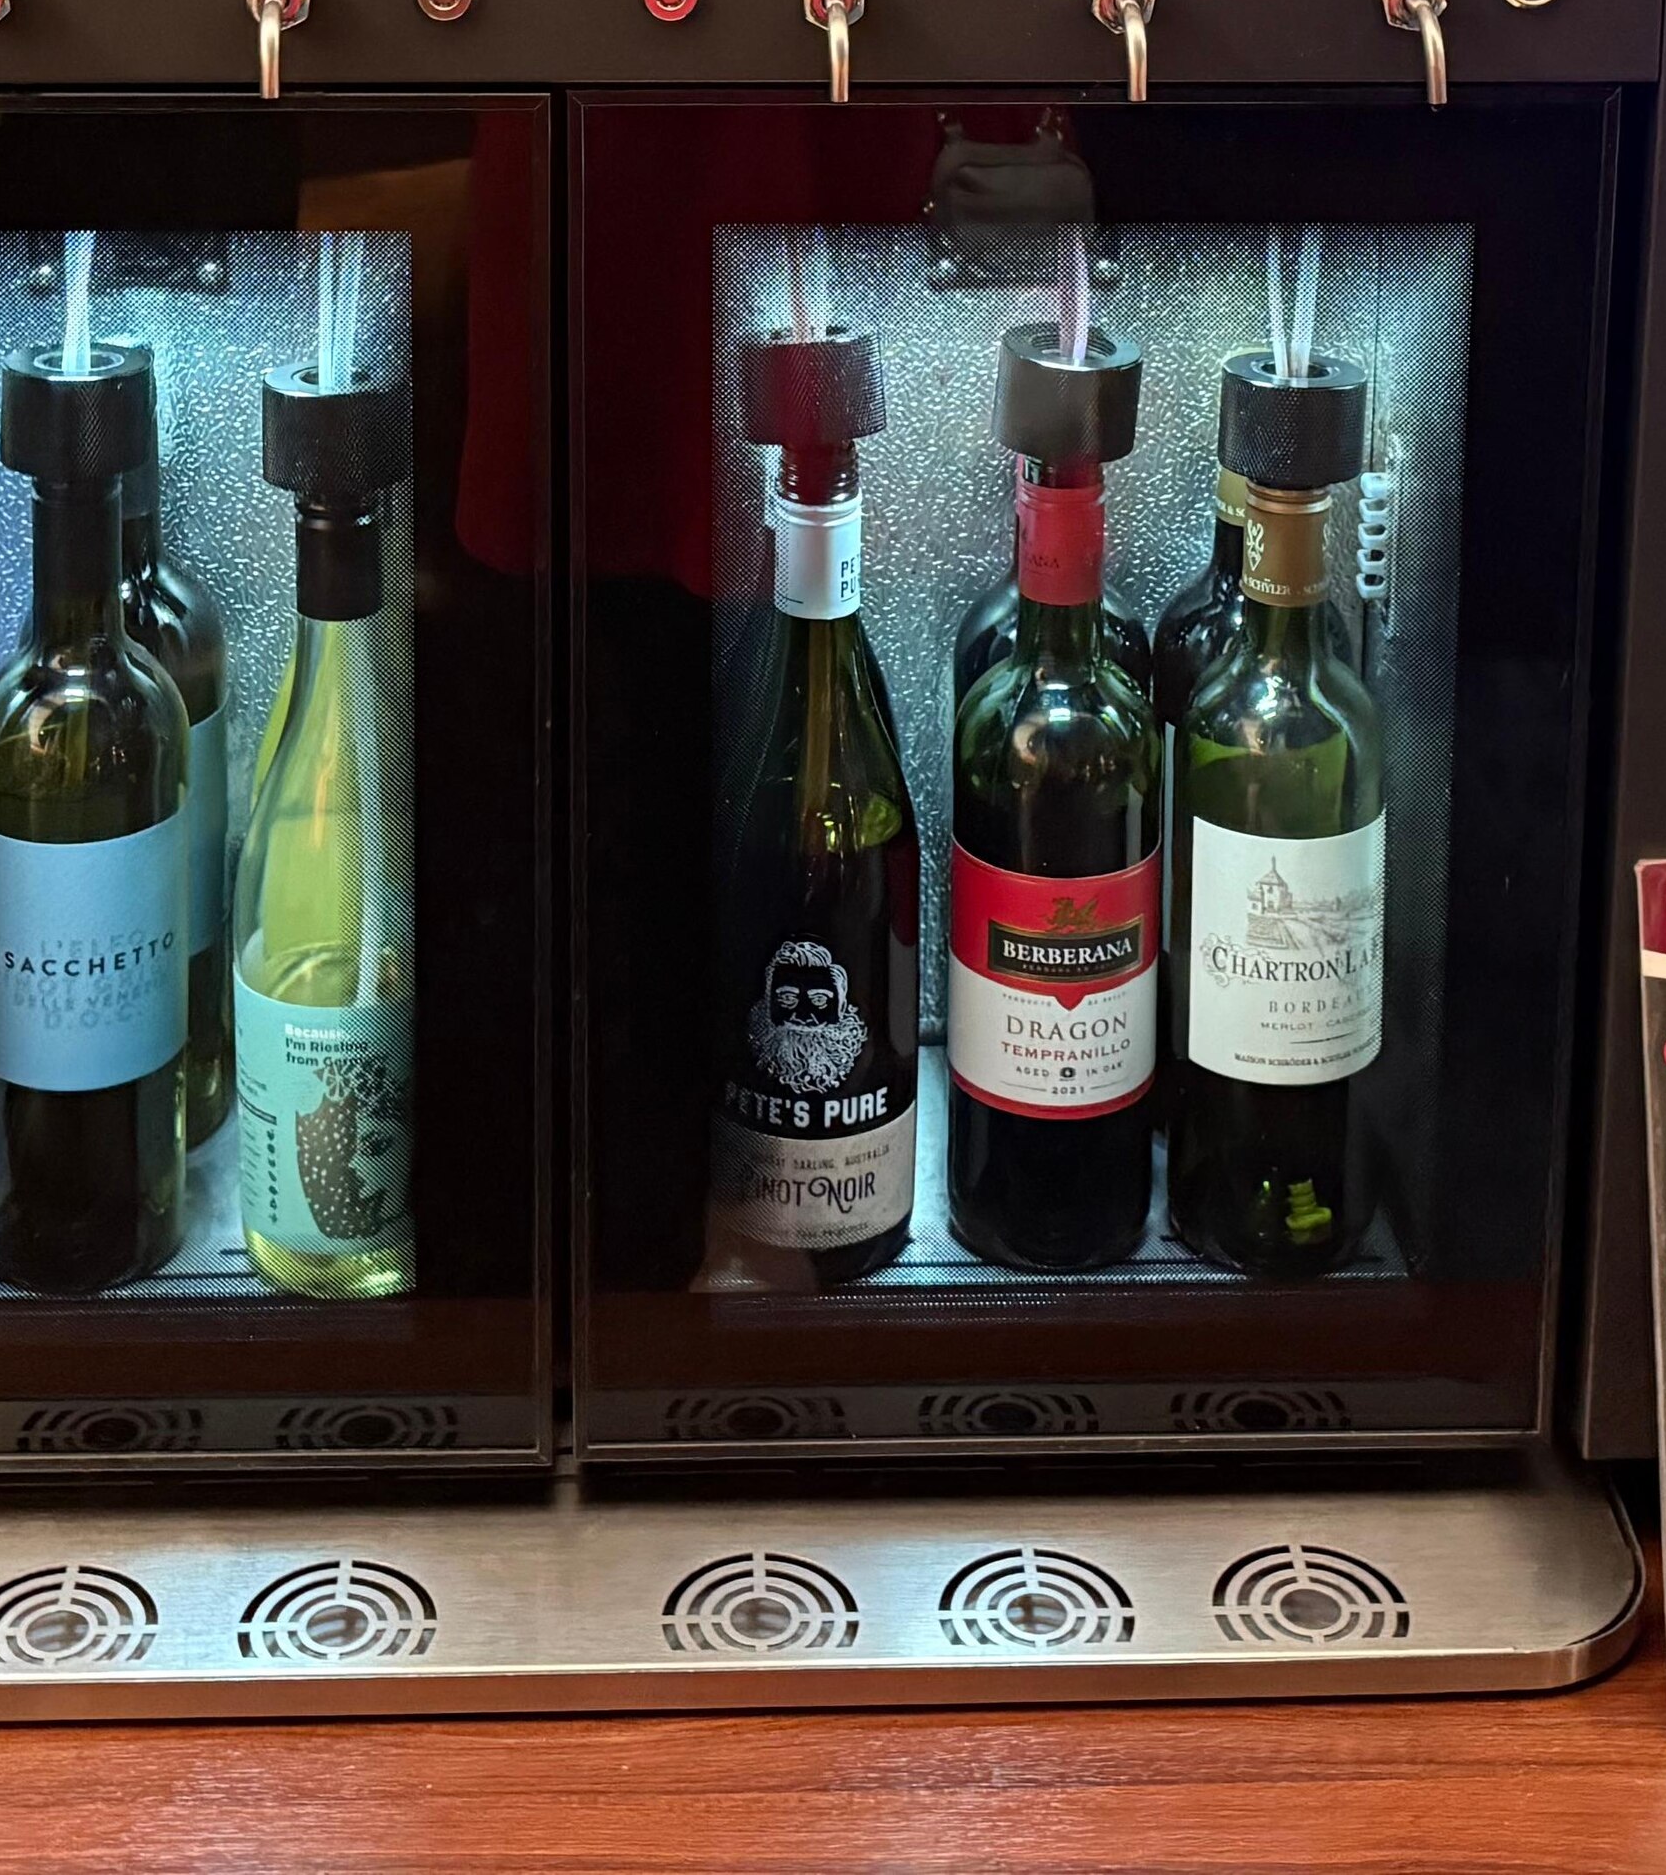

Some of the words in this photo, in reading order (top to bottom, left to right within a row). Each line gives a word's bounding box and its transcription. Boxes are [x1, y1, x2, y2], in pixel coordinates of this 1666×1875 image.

[4, 932, 174, 976] SACCHETTO
[1002, 937, 1133, 966] BERBERANA
[1211, 946, 1341, 983] CHARTRON
[1006, 1011, 1128, 1041] DRAGON
[1001, 1038, 1131, 1062] TEMPRANILLO
[823, 1086, 889, 1129] PURE
[808, 1171, 876, 1213] NOIR
